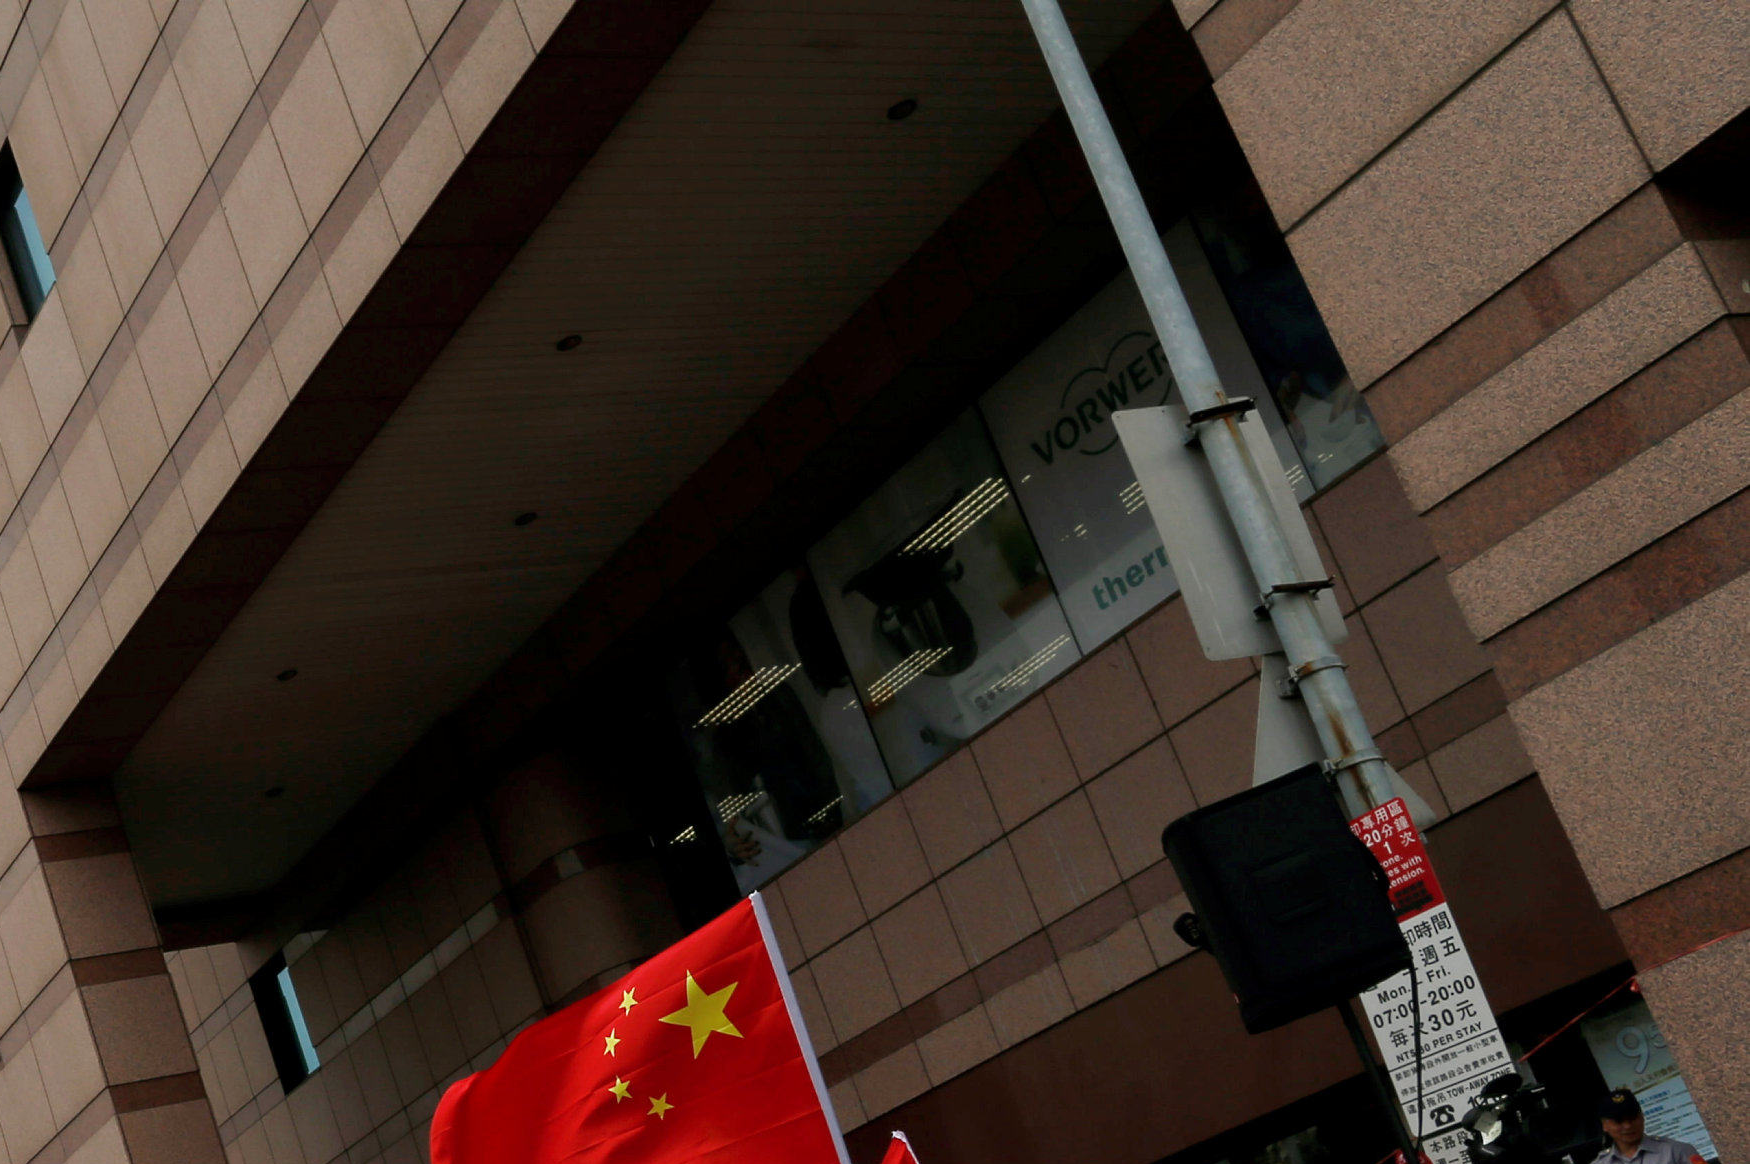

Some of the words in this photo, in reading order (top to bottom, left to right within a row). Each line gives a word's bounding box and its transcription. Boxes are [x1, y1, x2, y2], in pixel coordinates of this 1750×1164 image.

[1399, 831, 1416, 847] 次
[1401, 855, 1422, 870] with
[1377, 985, 1411, 1004] Mon.
[1426, 966, 1451, 982] Fri.
[1433, 1034, 1454, 1048] PER
[1456, 1022, 1483, 1040] STAY
[1446, 1074, 1490, 1098] TOW-AWAY
